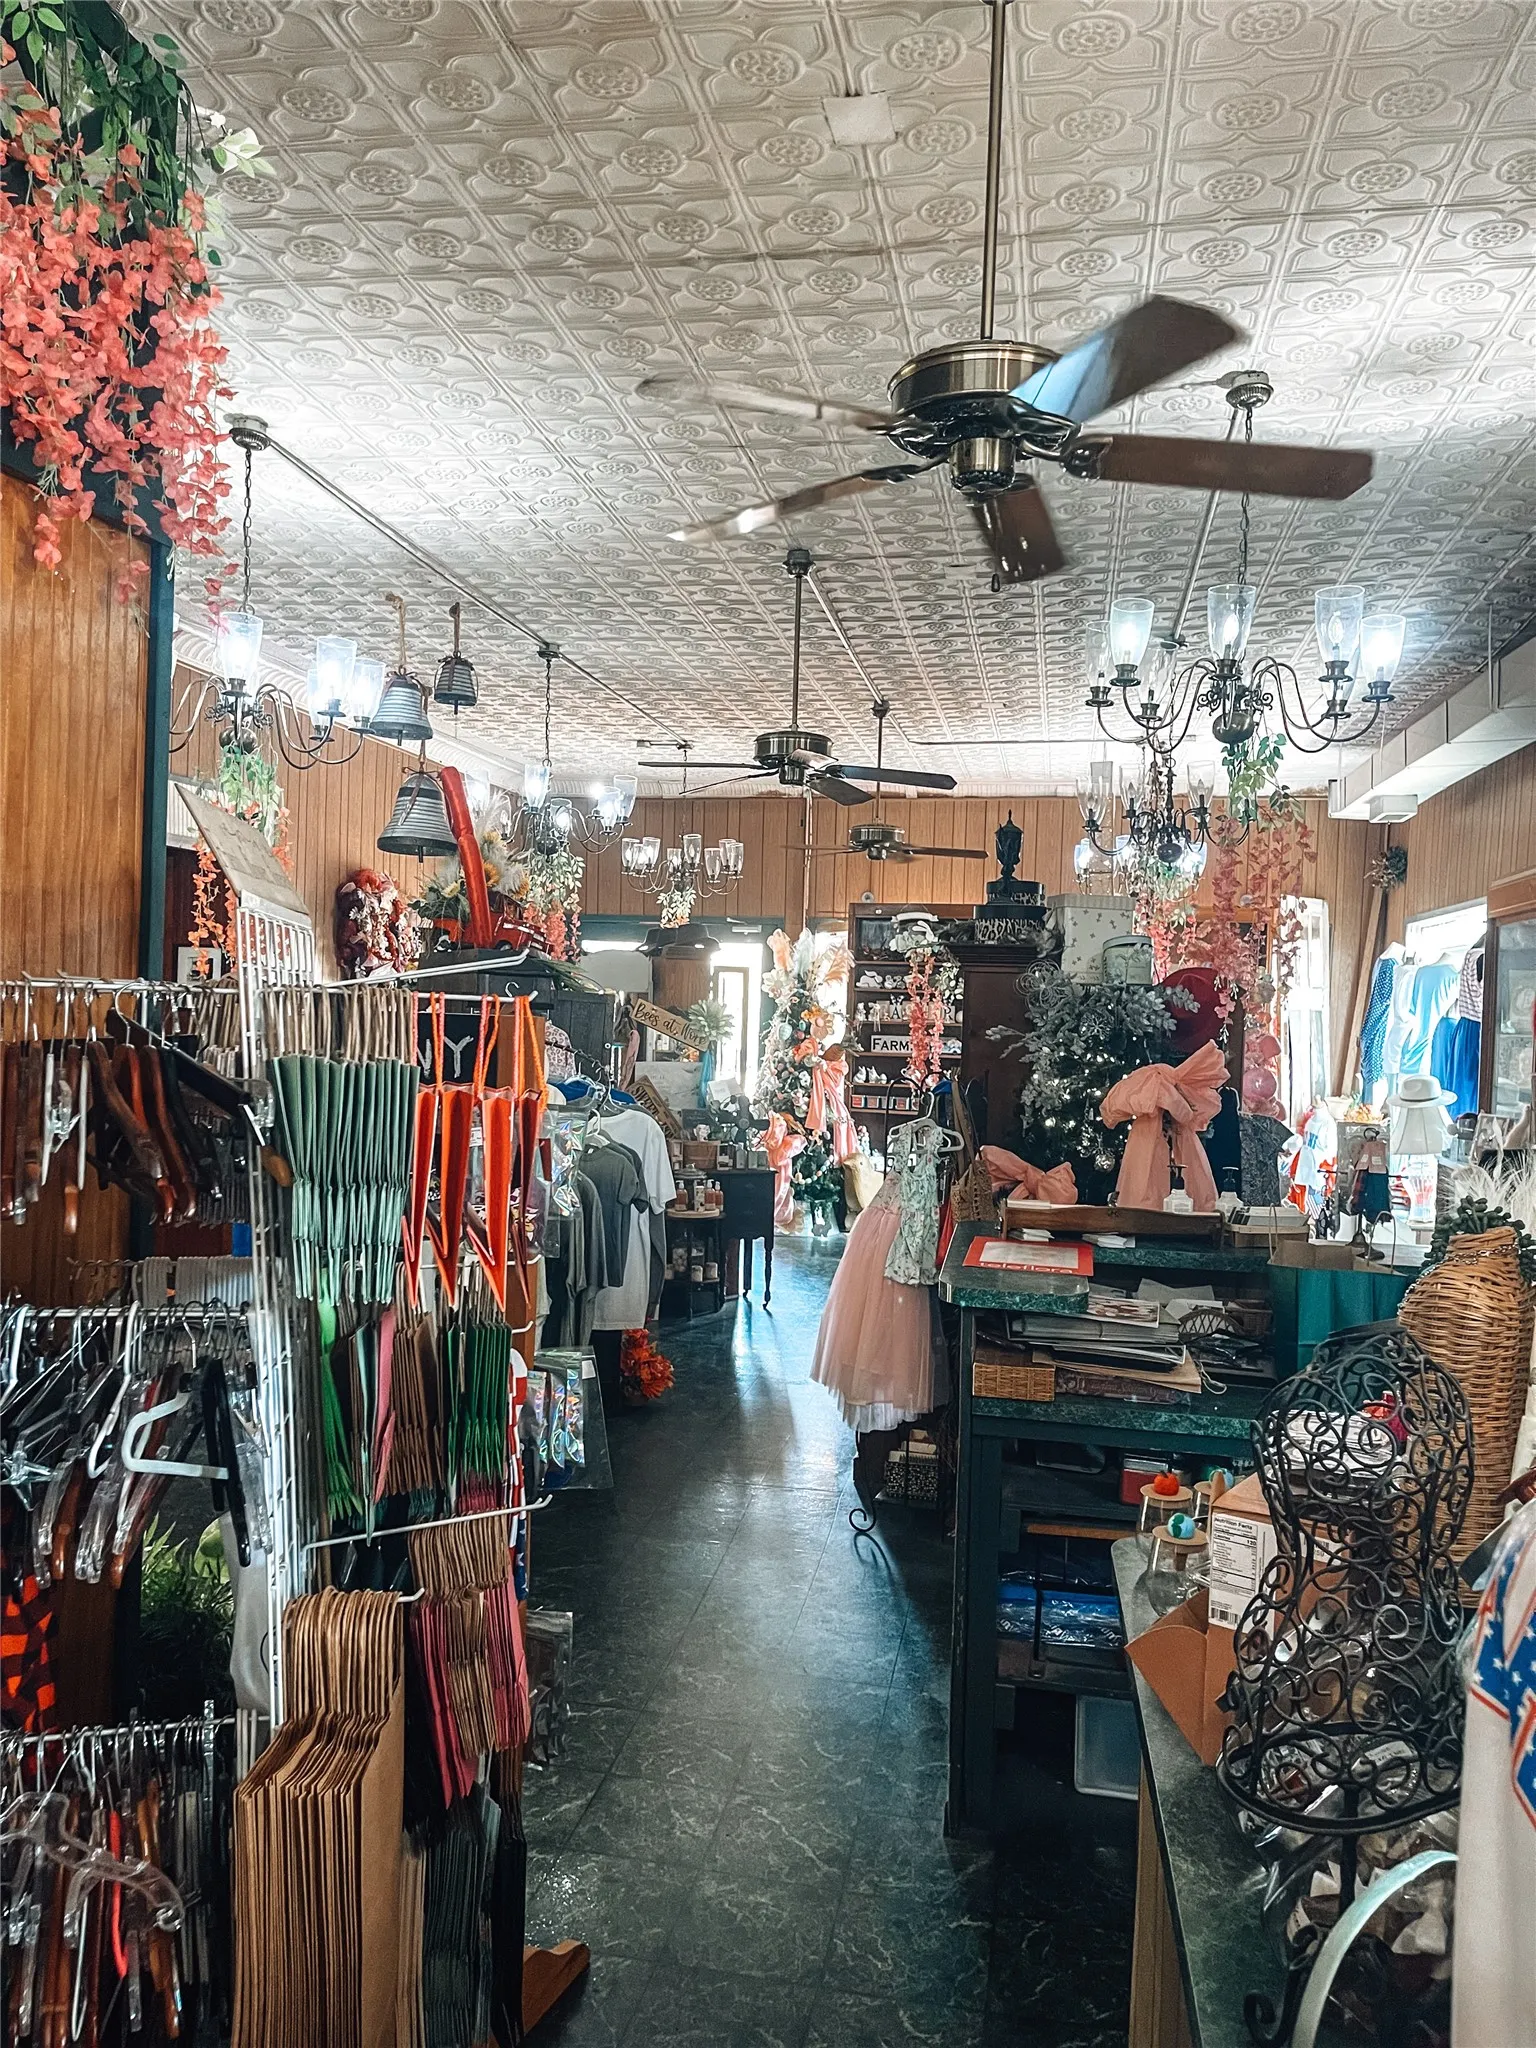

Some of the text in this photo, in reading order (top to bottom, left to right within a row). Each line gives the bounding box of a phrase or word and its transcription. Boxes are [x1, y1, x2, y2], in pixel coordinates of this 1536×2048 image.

[634, 1002, 660, 1027] Bees
[663, 1018, 682, 1034] at
[980, 1262, 1073, 1274] teleflora
